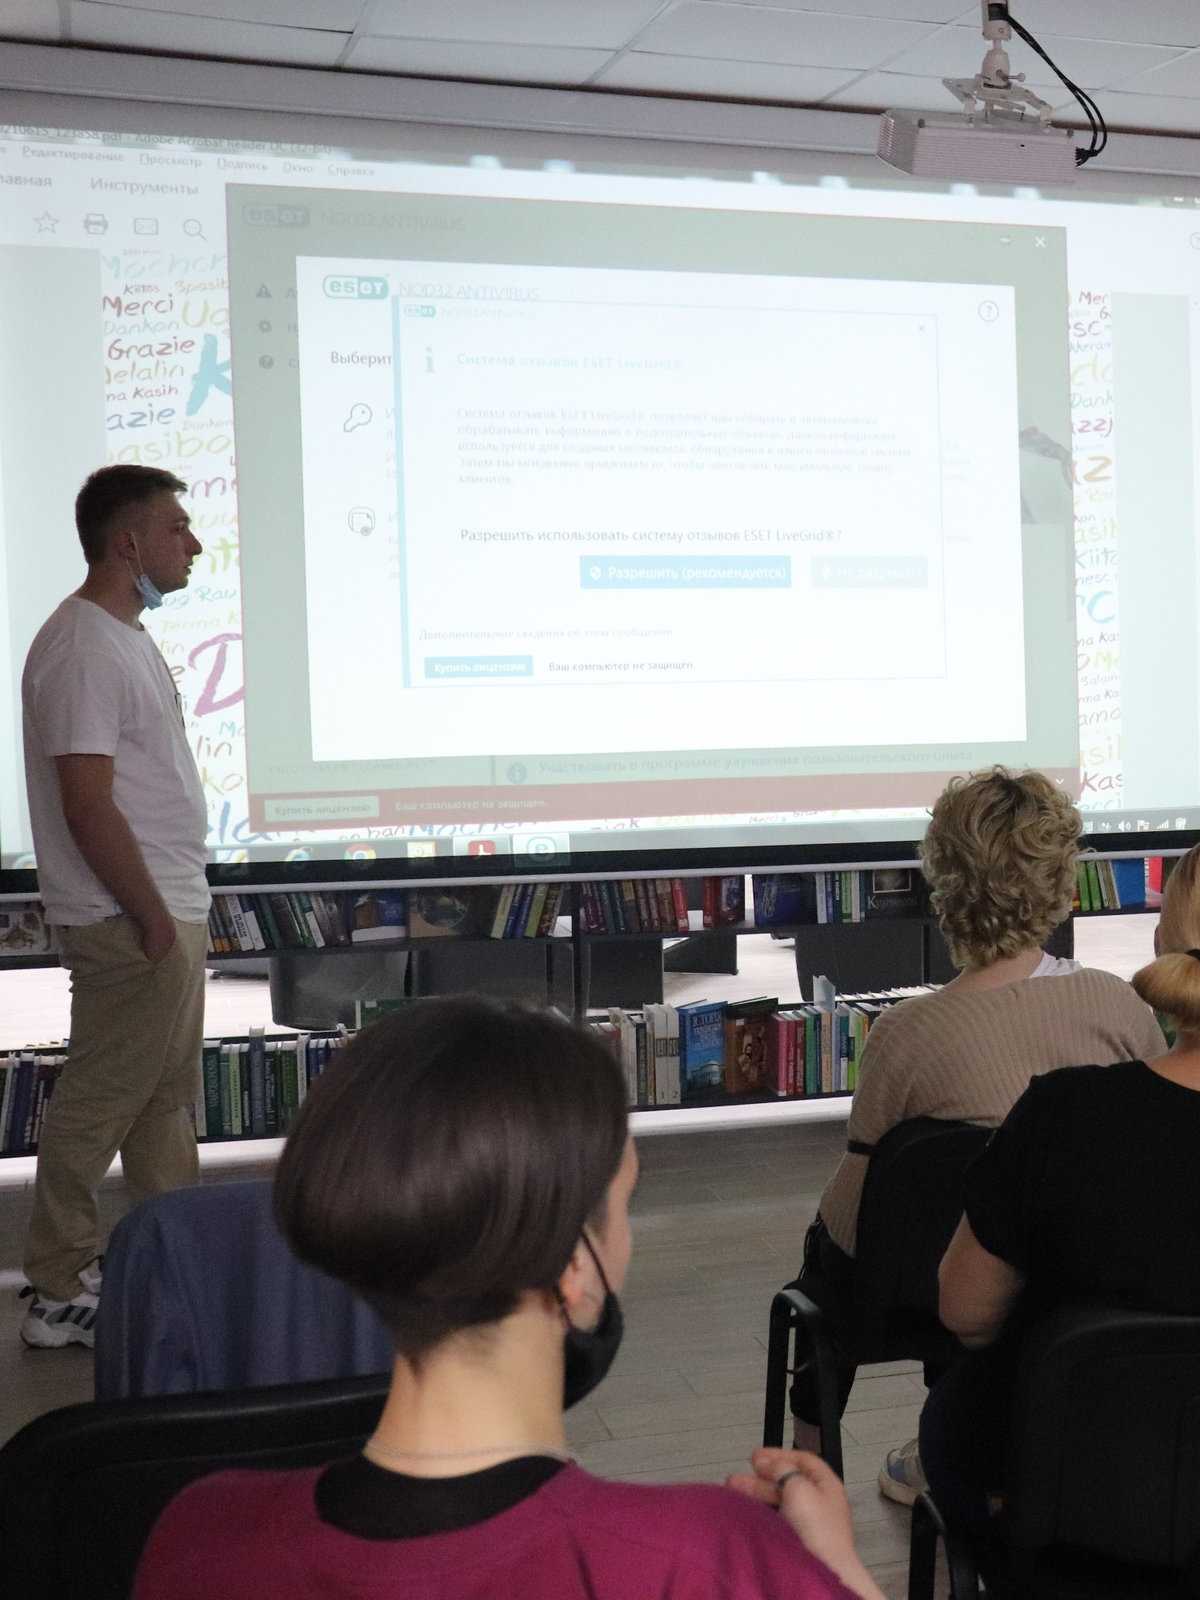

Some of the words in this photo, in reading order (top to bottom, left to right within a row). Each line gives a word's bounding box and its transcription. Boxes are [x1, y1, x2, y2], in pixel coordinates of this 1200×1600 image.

[22, 146, 125, 163] Редактирование
[139, 152, 203, 168] Просмотр
[217, 157, 269, 171] Подпись
[283, 161, 314, 173] Окно
[328, 163, 375, 177] Справка
[90, 177, 199, 196] Инструменты
[399, 282, 452, 298] NOD32
[456, 284, 540, 300] ANTIVIRUS
[102, 293, 173, 318] Merci
[107, 335, 196, 361] Grazie
[132, 384, 179, 400] Kasih
[460, 528, 534, 543] Разрешить
[538, 530, 629, 542] использовать
[632, 531, 683, 544] систему
[687, 531, 740, 542] отзывов
[744, 529, 771, 542] ESET
[608, 566, 678, 581] Разрешить
[682, 566, 787, 581] (рекомендуется)
[434, 662, 471, 674] Купить
[474, 661, 526, 674] лицензию
[548, 661, 570, 672] Ваш
[572, 661, 630, 673] компьютер
[633, 661, 645, 671] не
[537, 760, 626, 775] Участвовать
[642, 757, 721, 773] программе
[725, 754, 799, 770] улучшения
[803, 750, 930, 766] пользовательского
[275, 804, 313, 818] Купить
[315, 804, 371, 816] лицензию
